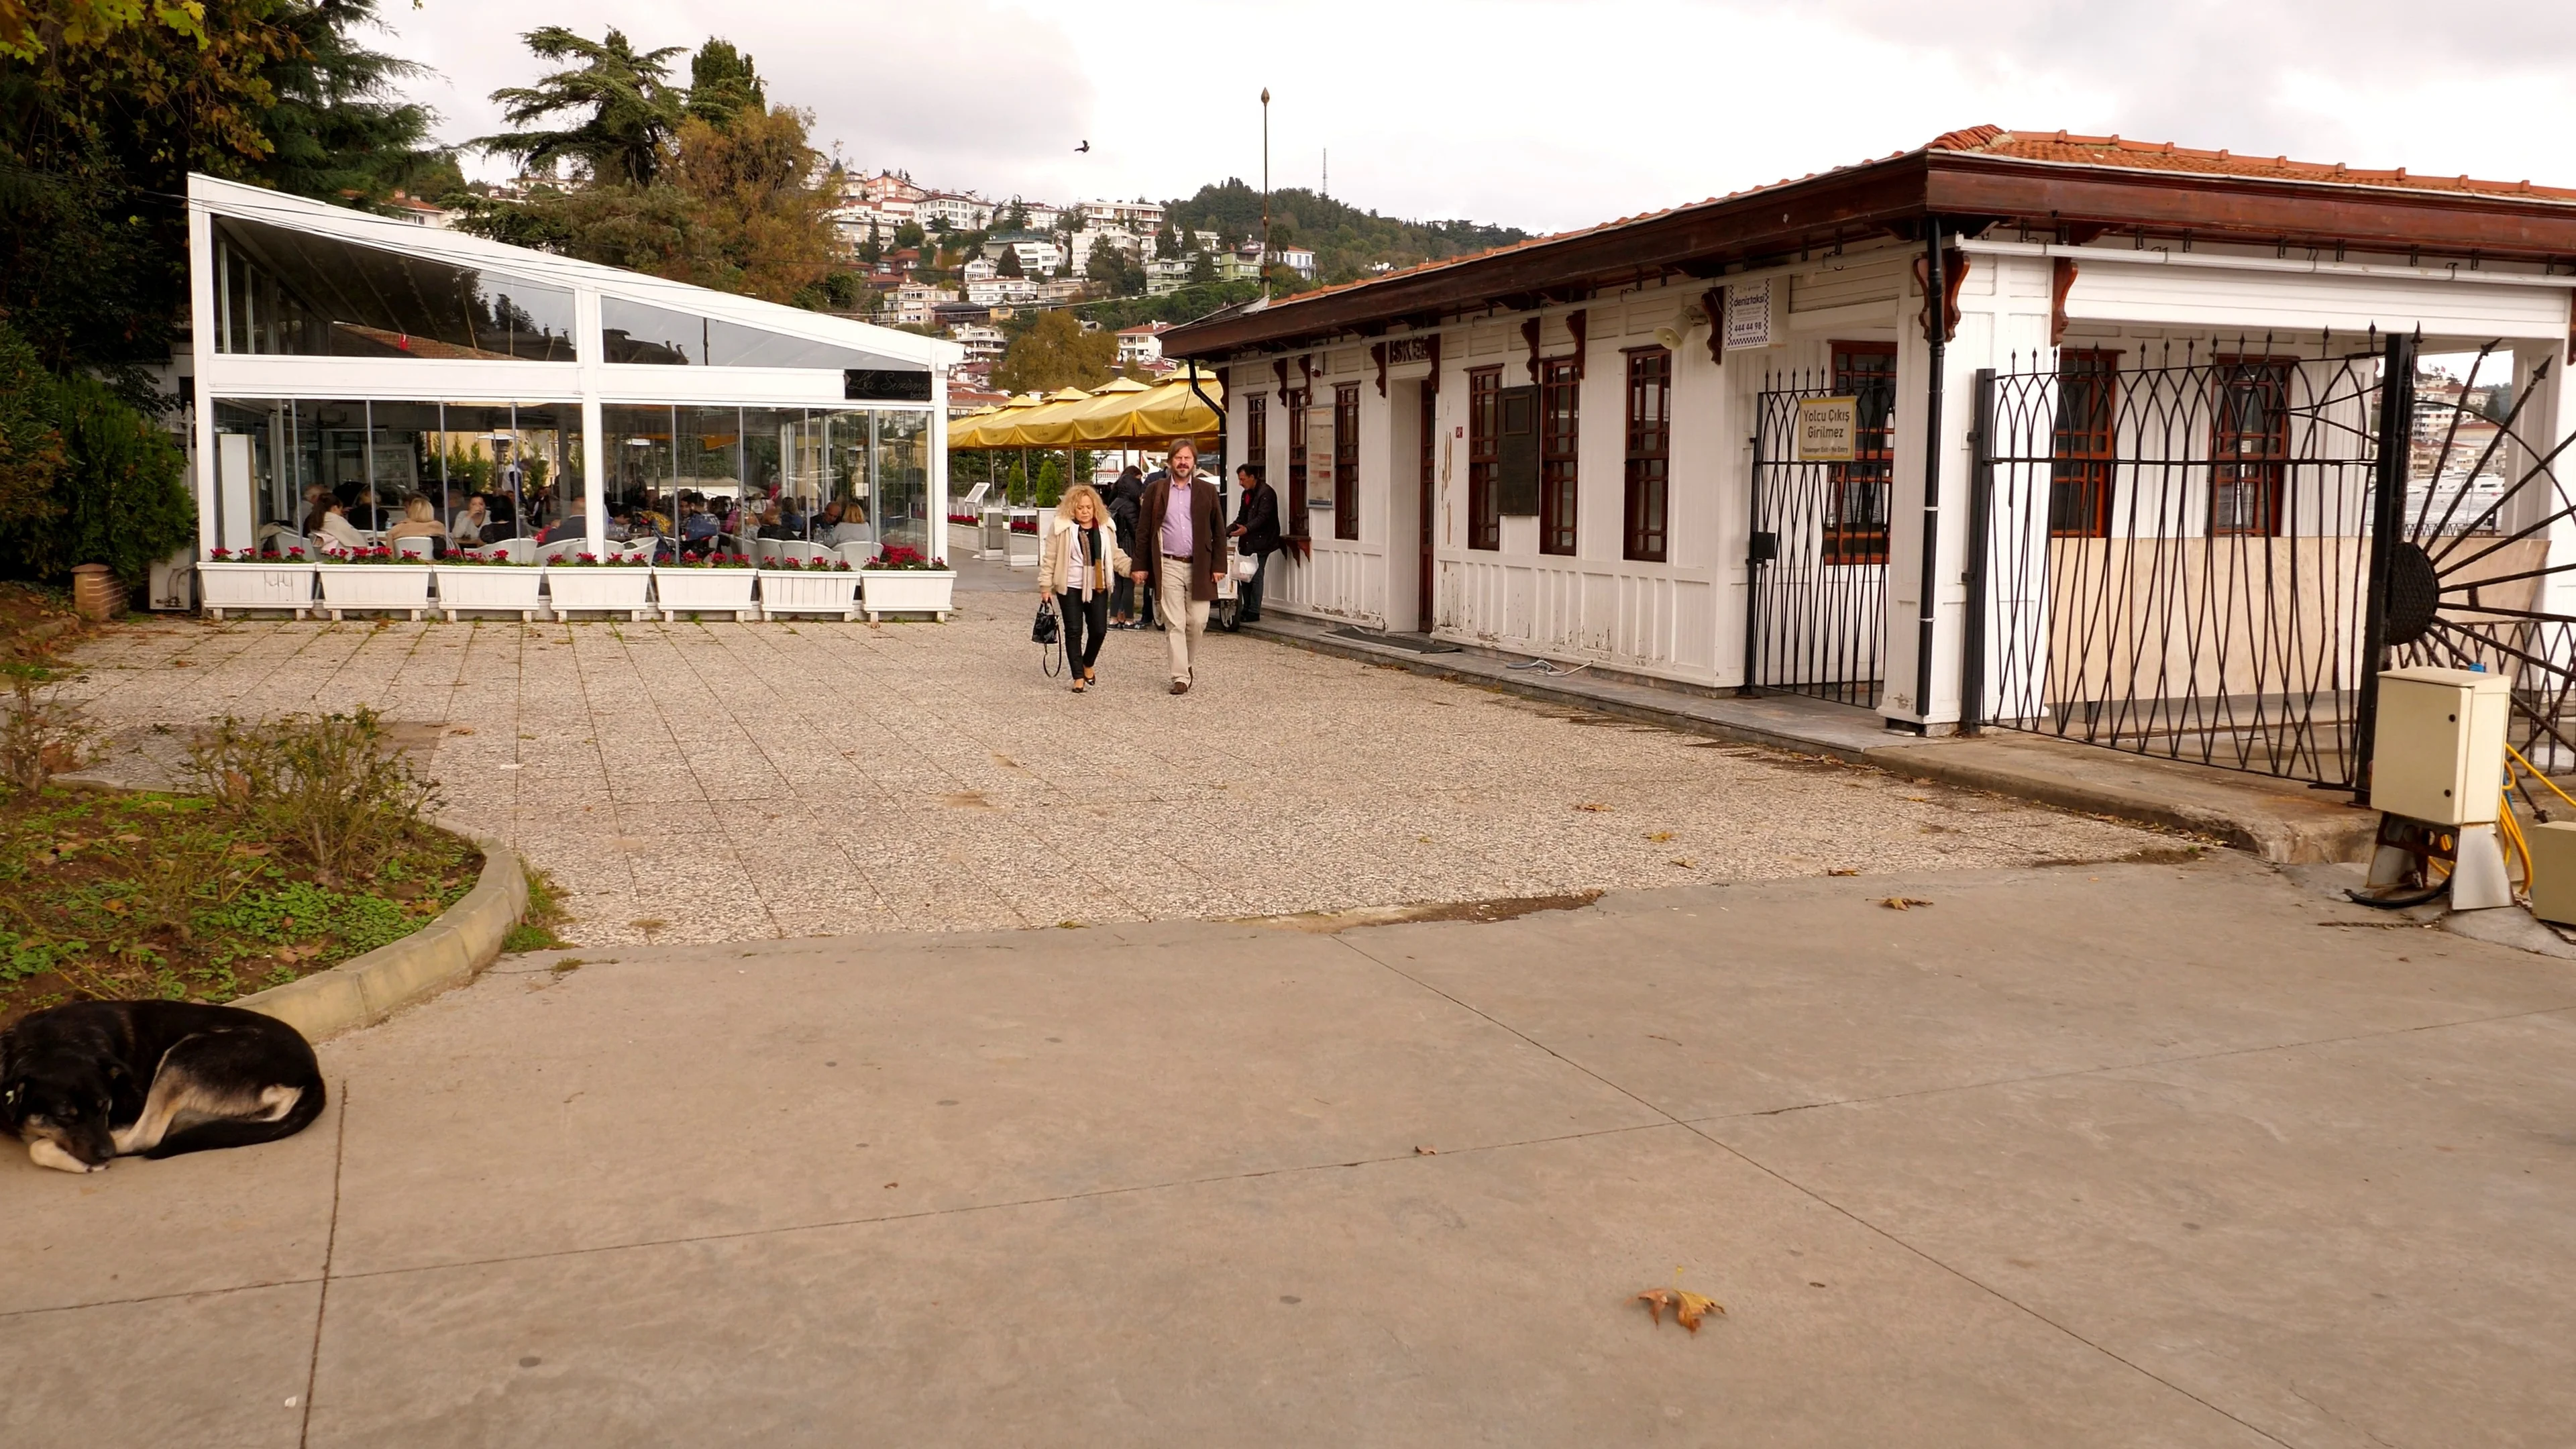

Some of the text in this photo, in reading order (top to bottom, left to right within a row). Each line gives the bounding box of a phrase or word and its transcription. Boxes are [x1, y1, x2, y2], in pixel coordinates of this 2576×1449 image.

[1733, 293, 1764, 307] deniztaksi
[1735, 324, 1744, 332] 444
[1803, 409, 1850, 423] Yolcu Çıkış
[1808, 425, 1844, 438] Girilmez
